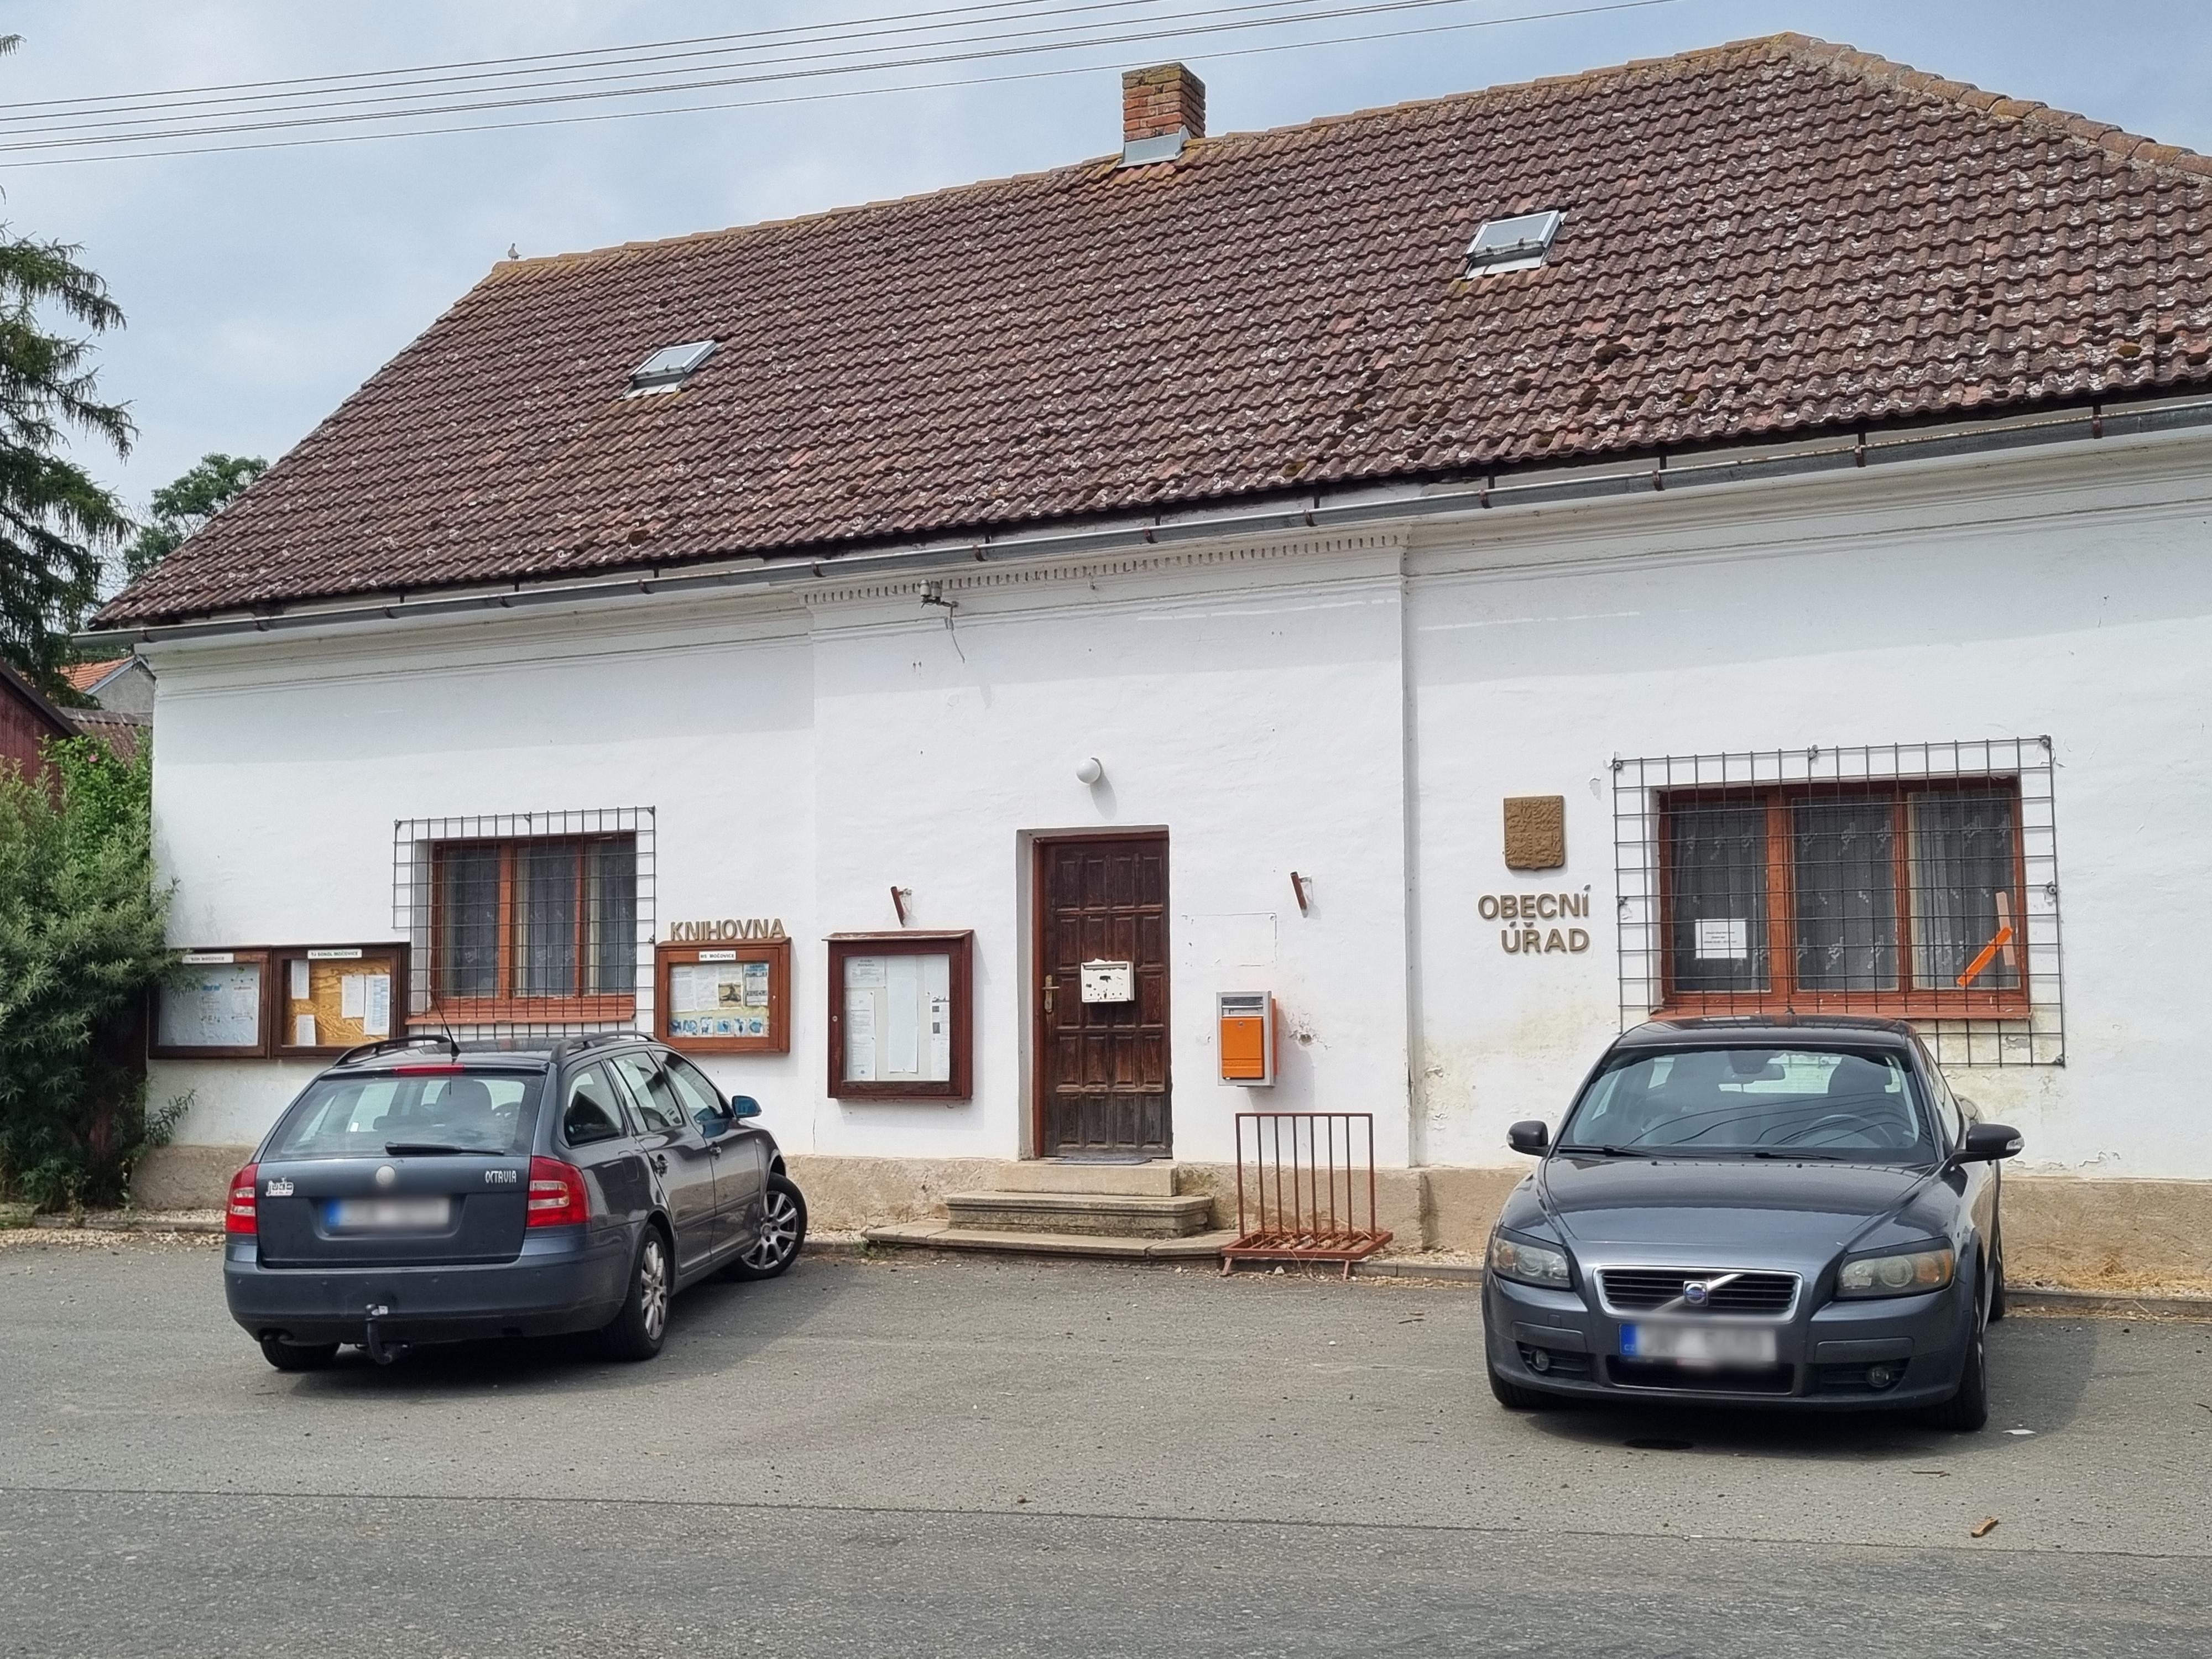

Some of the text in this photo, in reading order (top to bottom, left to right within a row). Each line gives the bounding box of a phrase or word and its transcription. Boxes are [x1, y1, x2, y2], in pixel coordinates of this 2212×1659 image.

[1478, 884, 1591, 920] OBECNÍ
[670, 918, 786, 940] KNIHOVNA
[1501, 921, 1590, 953] ÚŘAD
[485, 1170, 517, 1183] OCTAVIA
